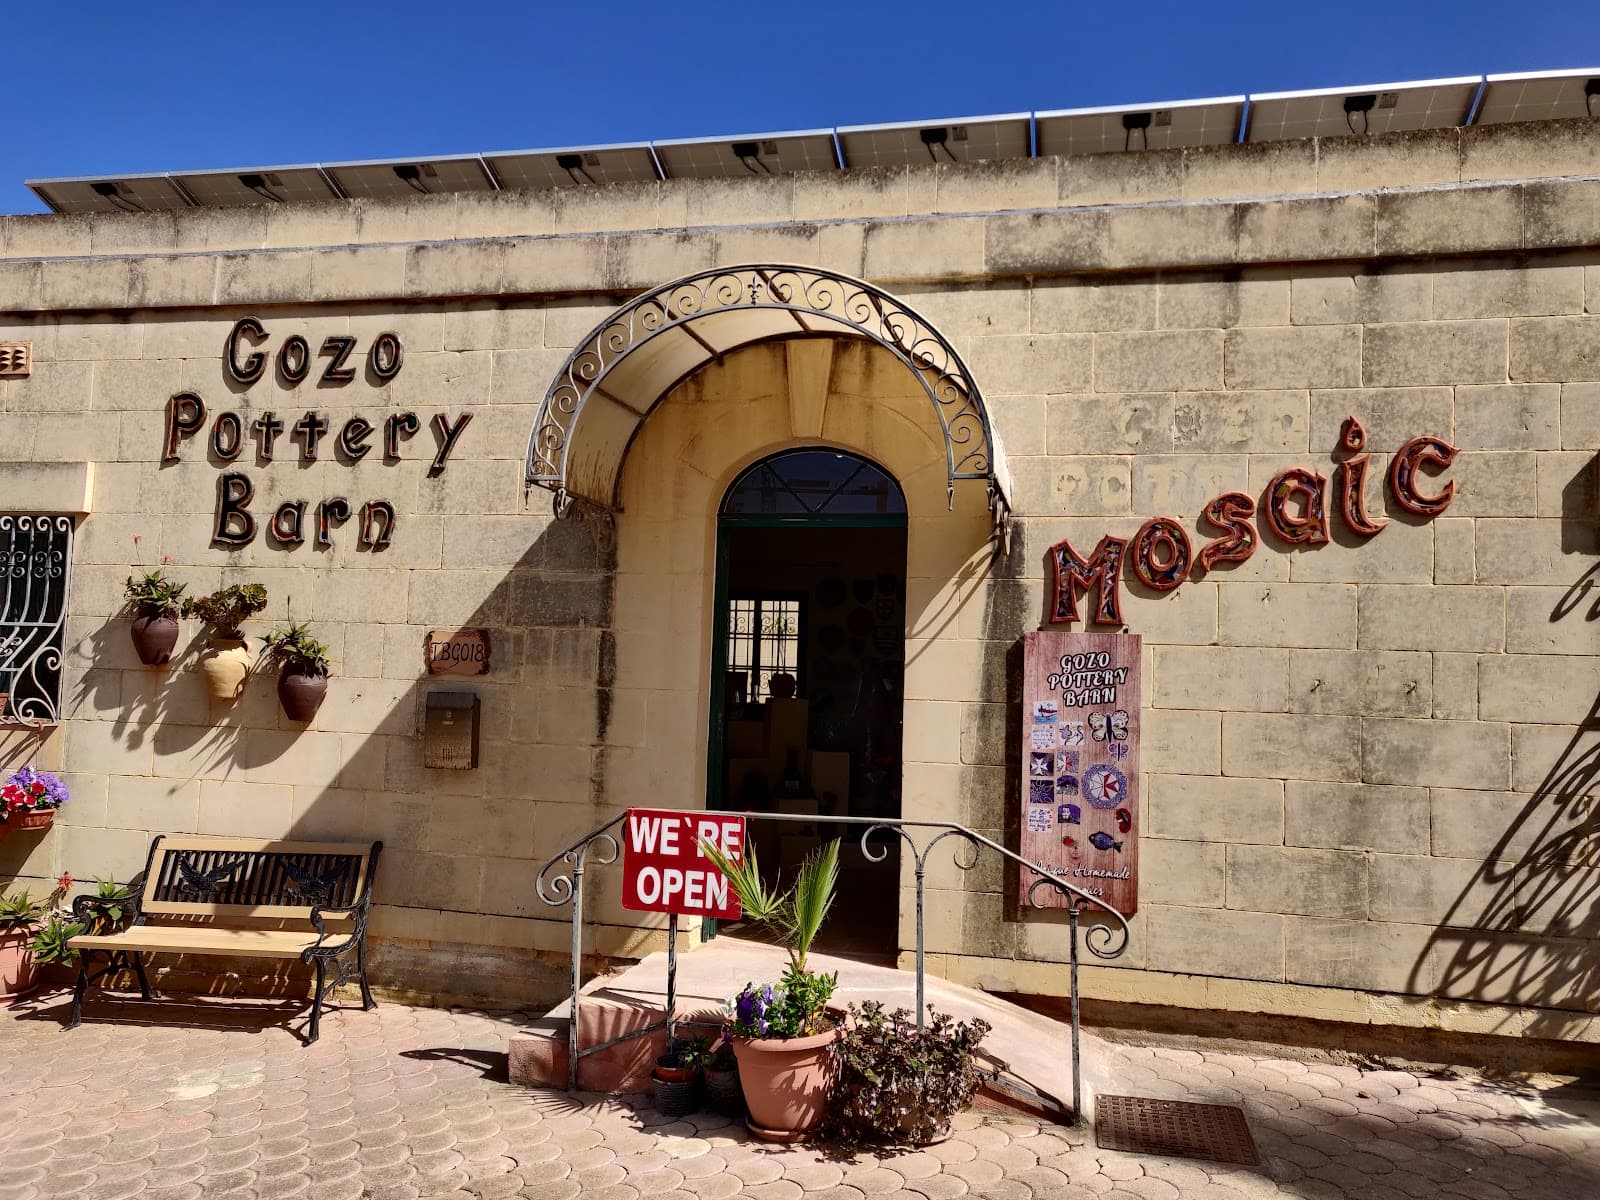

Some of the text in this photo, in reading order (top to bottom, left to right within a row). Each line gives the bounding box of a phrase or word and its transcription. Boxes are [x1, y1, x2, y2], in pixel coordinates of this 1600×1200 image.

[227, 316, 404, 383] Gozo
[165, 391, 474, 476] Pottery
[214, 472, 396, 545] Barn
[1050, 416, 1461, 625] Mosaic
[430, 641, 484, 668] TBG018
[1061, 652, 1111, 674] GOZO
[1048, 668, 1128, 691] POTTERY
[1063, 687, 1116, 707] BARN
[637, 866, 728, 911] OPEN
[1074, 863, 1130, 880] Homemade
